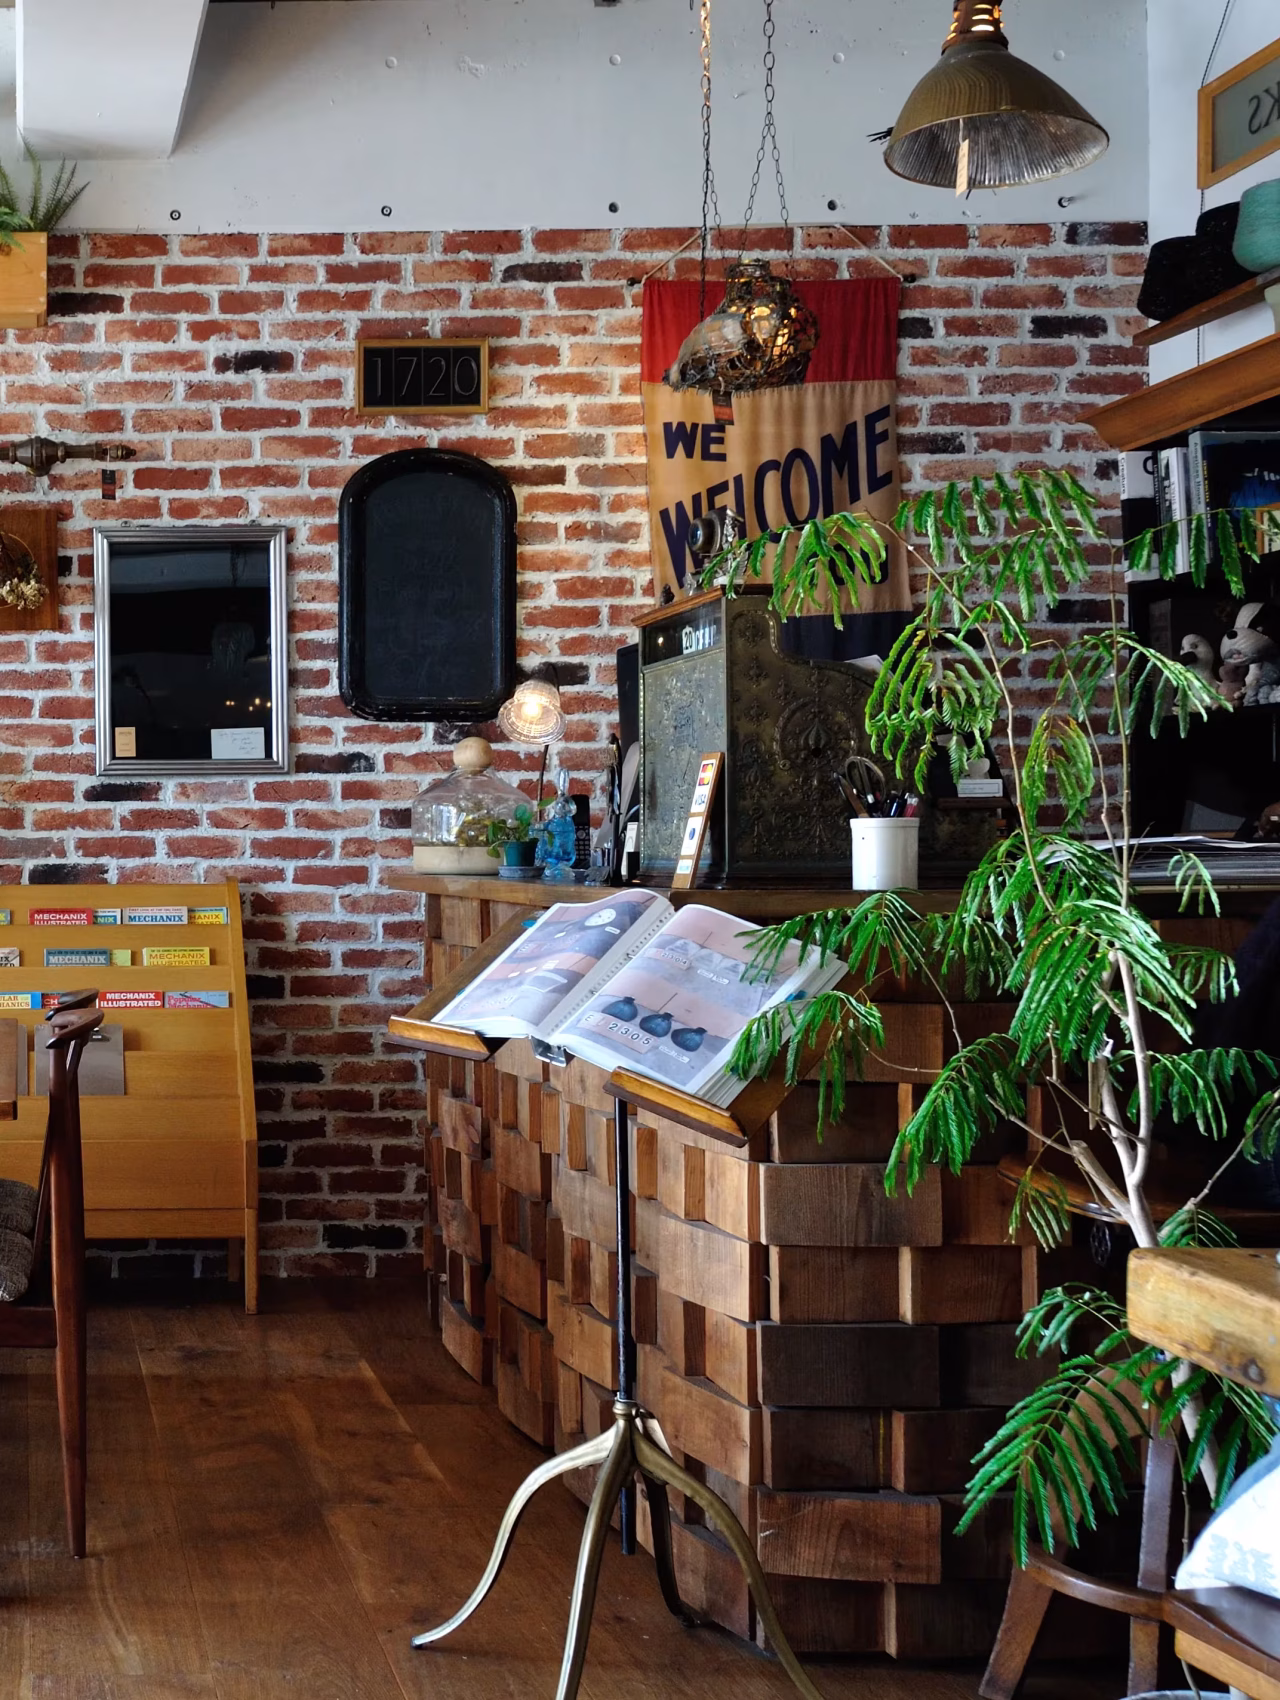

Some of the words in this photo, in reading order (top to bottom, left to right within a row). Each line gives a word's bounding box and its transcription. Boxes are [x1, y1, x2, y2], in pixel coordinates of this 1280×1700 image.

[372, 356, 478, 397] 1720
[663, 421, 727, 462] WE
[128, 914, 184, 922] MECHANIX
[49, 955, 107, 964] MECHANIX
[661, 952, 688, 965] 2304
[100, 1000, 162, 1008] ILLUSTRATED
[608, 1022, 652, 1045] 2305
